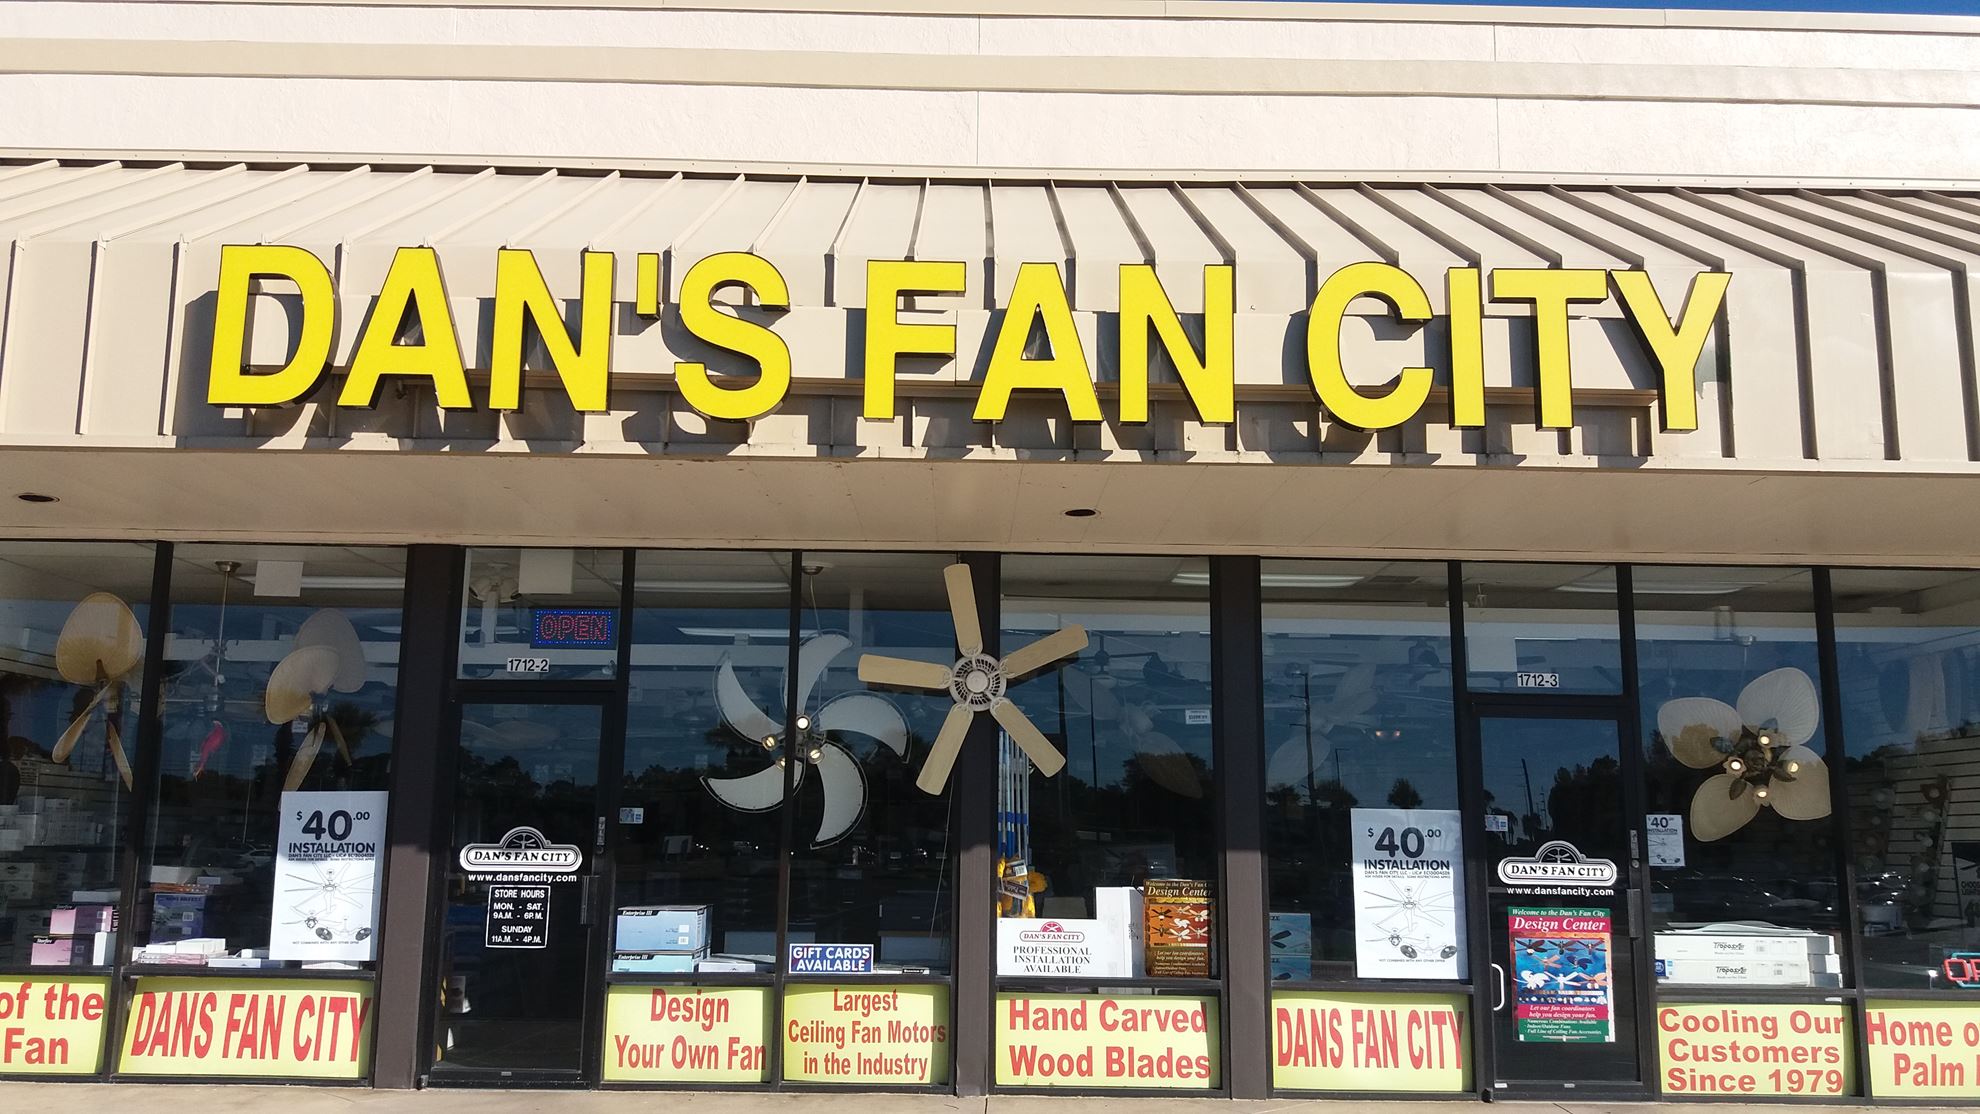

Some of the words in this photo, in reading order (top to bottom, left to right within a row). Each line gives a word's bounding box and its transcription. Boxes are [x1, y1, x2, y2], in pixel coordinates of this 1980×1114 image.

[207, 244, 791, 421] DAN'S
[862, 259, 1235, 427] FAN
[1306, 261, 1733, 433] CITY
[541, 615, 607, 640] OPEN
[508, 659, 548, 672] 1712-2
[1518, 674, 1558, 687] 1712-3
[1650, 816, 1669, 828] 40
[288, 842, 376, 853] INSTALLATION
[474, 851, 512, 861] DAN'S
[515, 852, 539, 862] FAN
[541, 853, 571, 862] CITY
[1364, 859, 1450, 870] INSTALLATION
[1511, 865, 1549, 875] DAN'S
[1551, 866, 1575, 876] FAN
[1578, 867, 1606, 877] CITY
[468, 873, 577, 883] www.dansfancity.com
[494, 889, 518, 898] STORE
[520, 889, 545, 899] HOURS
[1147, 886, 1179, 898] Design
[1182, 886, 1211, 896] Center
[1507, 887, 1614, 897] www.dansfancity.com
[493, 902, 514, 910] MON.
[526, 902, 544, 911] SAT.
[1512, 908, 1540, 916] Welcome
[1592, 910, 1605, 918] City
[501, 925, 533, 933] SUNDAY
[1514, 917, 1558, 932] Design
[1562, 917, 1606, 930] Center
[793, 947, 822, 959] GIFT
[825, 947, 870, 959] CARDS
[1013, 945, 1092, 955] PROFESSIONAL
[796, 959, 866, 971] AVAILABLE
[1014, 955, 1090, 964] INSTALLATION
[1024, 965, 1081, 973] AVAILABLE
[0, 982, 33, 1020] of
[44, 983, 104, 1020] the
[834, 988, 898, 1017] Largest
[651, 988, 729, 1031] Design
[1009, 999, 1088, 1031] Hand
[1099, 999, 1208, 1033] Carved
[1553, 1011, 1571, 1019] design
[130, 991, 217, 1059] DANS
[222, 993, 287, 1060] FAN
[293, 994, 372, 1062] CITY
[1659, 1008, 1779, 1040] Cooling
[1790, 1010, 1845, 1034] Our
[1865, 1011, 1953, 1047] Home
[788, 1019, 846, 1050] Ceiling
[851, 1020, 882, 1043] Fan
[888, 1019, 946, 1044] Motors
[1276, 1007, 1344, 1069] DANS
[1351, 1008, 1400, 1069] FAN
[1407, 1009, 1465, 1071] CITY
[4, 1028, 69, 1064] Fan
[614, 1034, 665, 1069] Your
[671, 1035, 719, 1070] Own
[727, 1036, 766, 1071] Fan
[1667, 1038, 1840, 1064] Customers
[804, 1051, 818, 1074] in
[823, 1051, 851, 1075] the
[857, 1051, 928, 1081] Industry
[1008, 1045, 1093, 1078] Wood
[1105, 1045, 1211, 1079] Blades
[1893, 1053, 1965, 1087] Palm
[1667, 1067, 1757, 1093] Since
[1768, 1069, 1844, 1094] 1979
